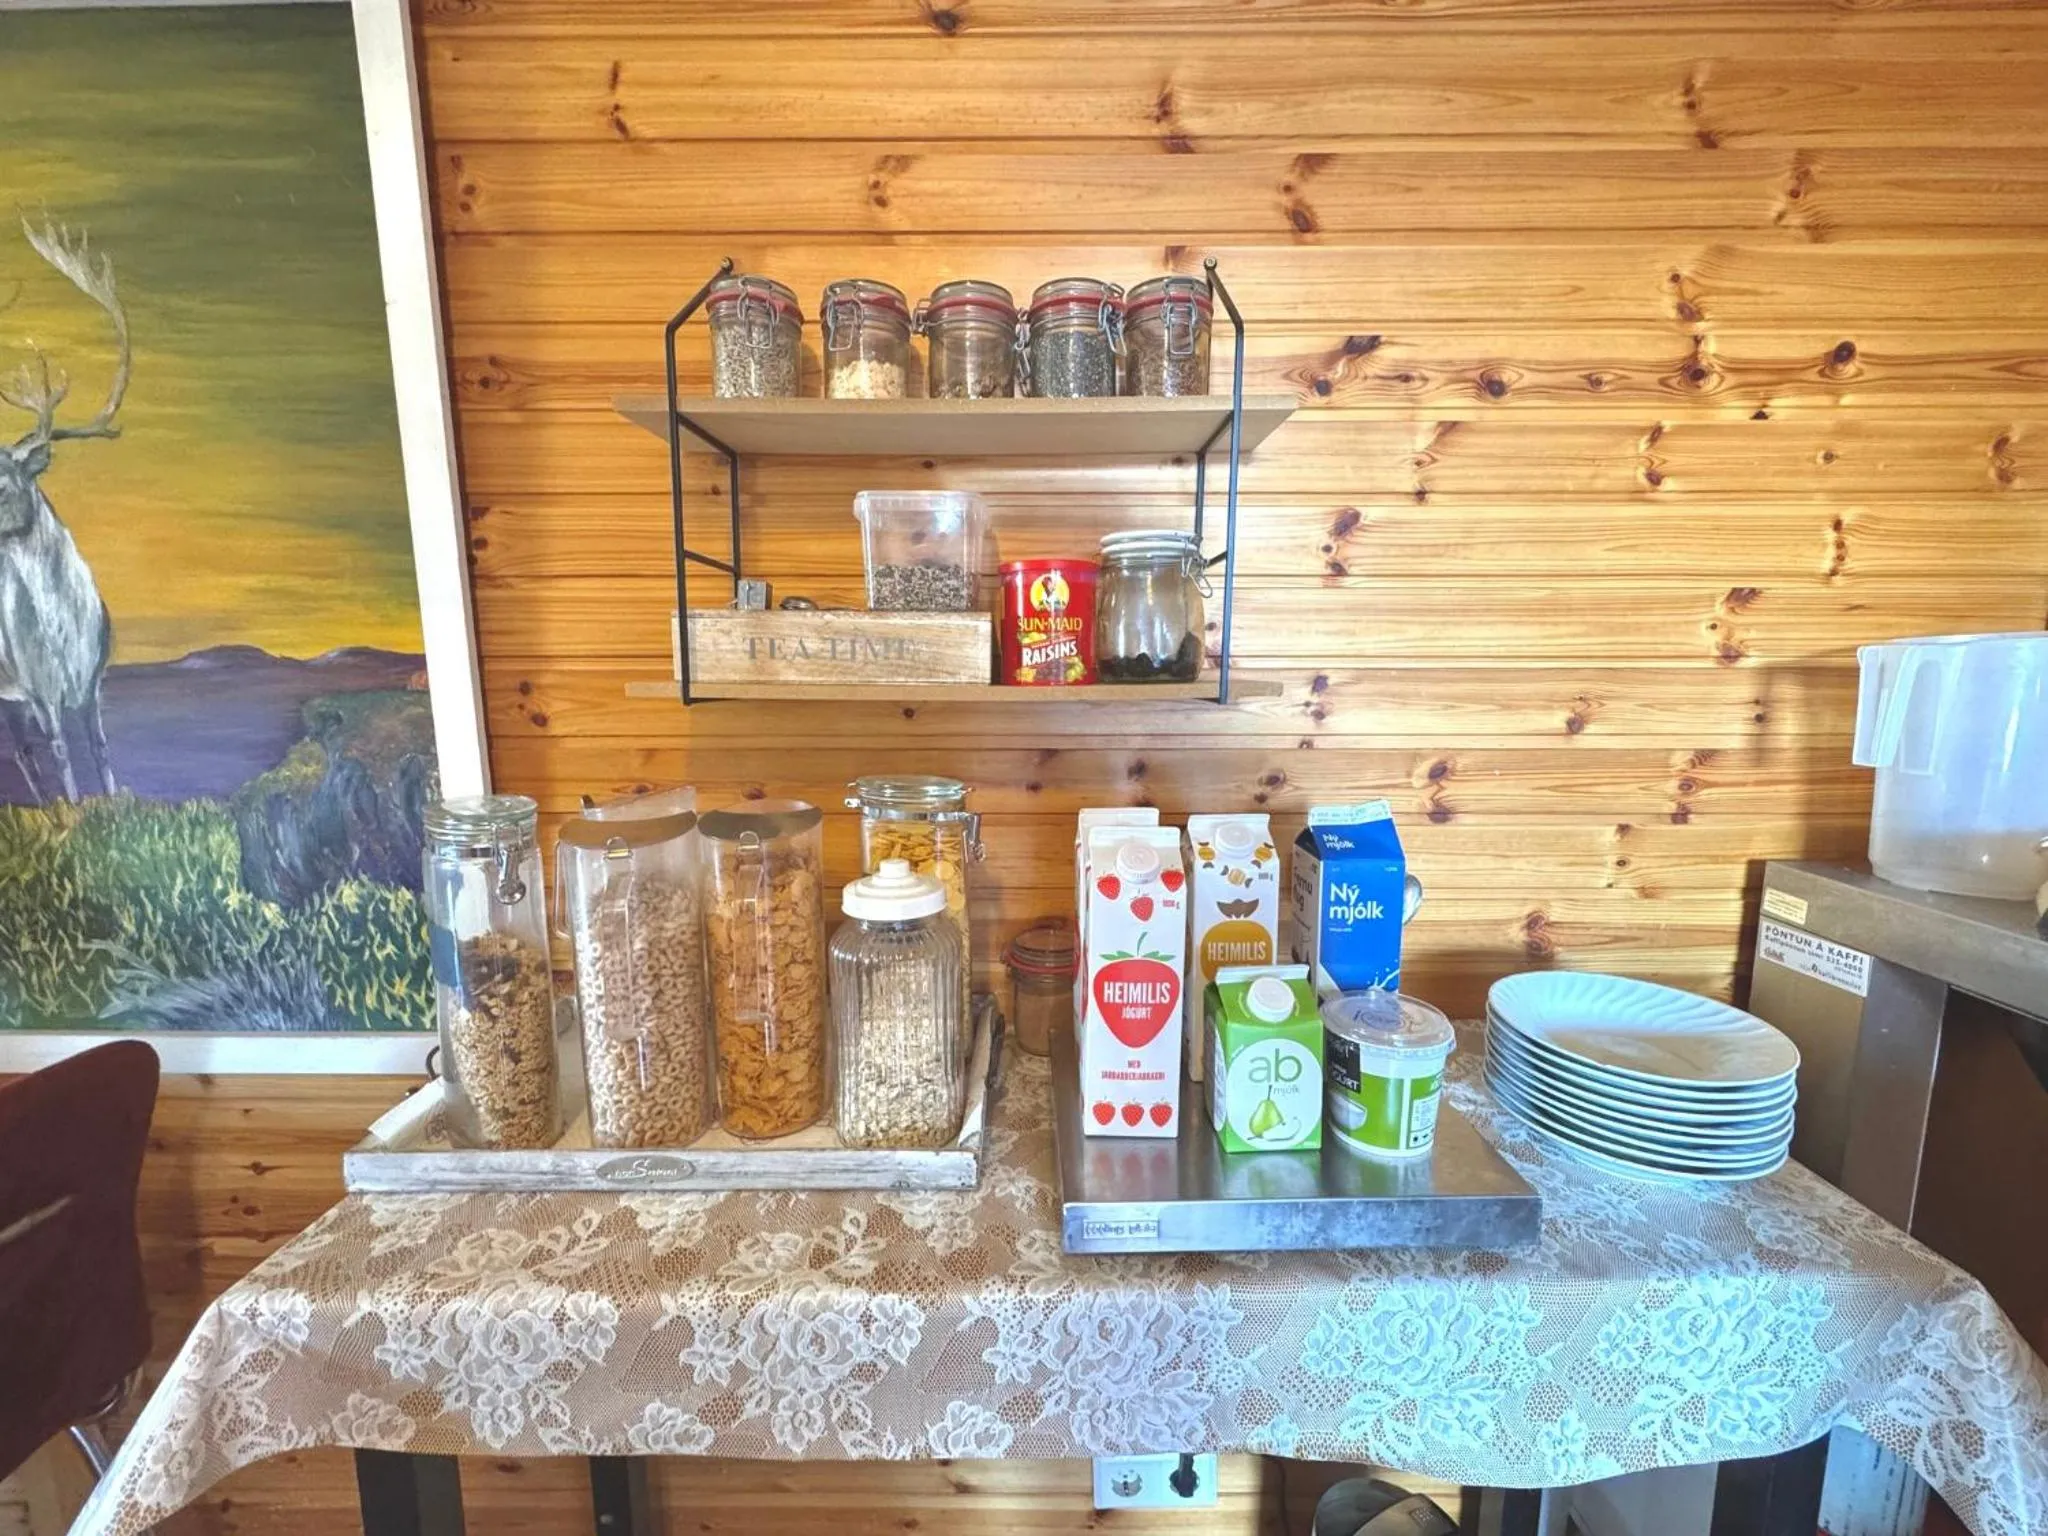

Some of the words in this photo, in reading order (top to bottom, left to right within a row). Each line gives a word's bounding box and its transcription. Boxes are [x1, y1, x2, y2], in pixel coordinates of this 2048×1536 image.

[743, 636, 812, 661] TEA
[822, 636, 918, 662] TIME
[1021, 640, 1078, 667] RAISINS
[1329, 881, 1361, 906] Ný
[1328, 901, 1385, 925] mjólk
[1207, 940, 1267, 962] HEIMILIS
[1103, 981, 1171, 1005] HEIMILIS
[1248, 1047, 1303, 1083] ab
